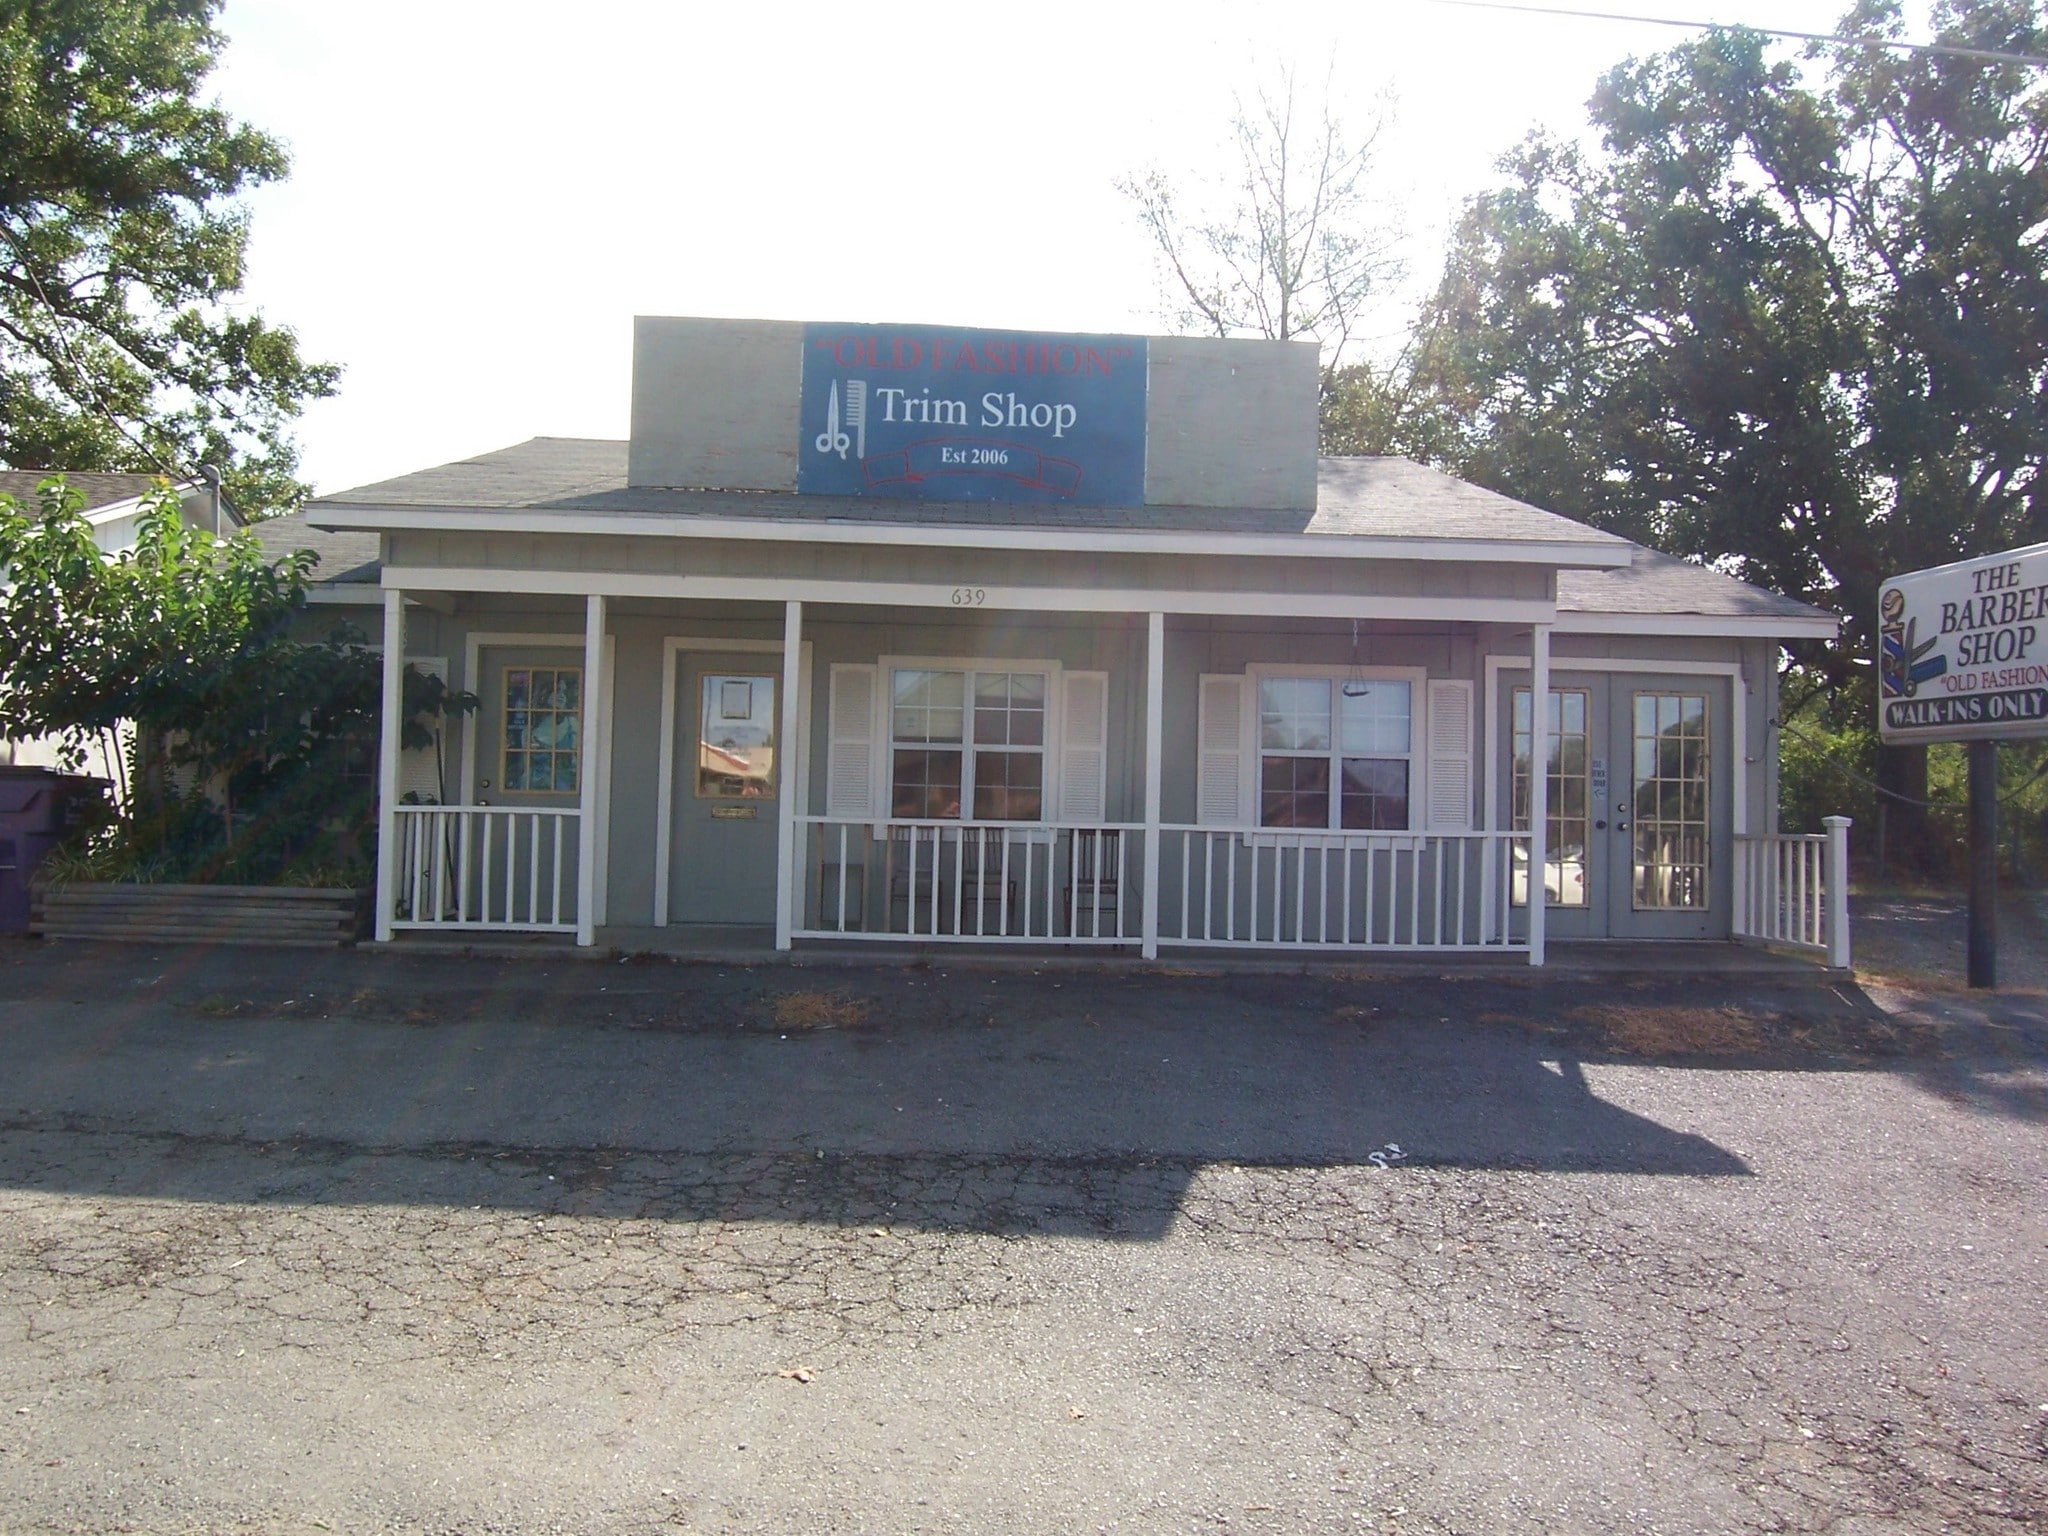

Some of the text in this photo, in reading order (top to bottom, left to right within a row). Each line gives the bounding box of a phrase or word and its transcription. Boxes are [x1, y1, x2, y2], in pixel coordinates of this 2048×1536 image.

[876, 387, 1077, 438] Trim Shop
[941, 447, 1009, 465] Est 2006
[1972, 562, 2021, 594] THE
[951, 588, 985, 606] 639
[1957, 625, 2036, 667] SHOP
[1891, 692, 2043, 725] WALK-INS ONLY
